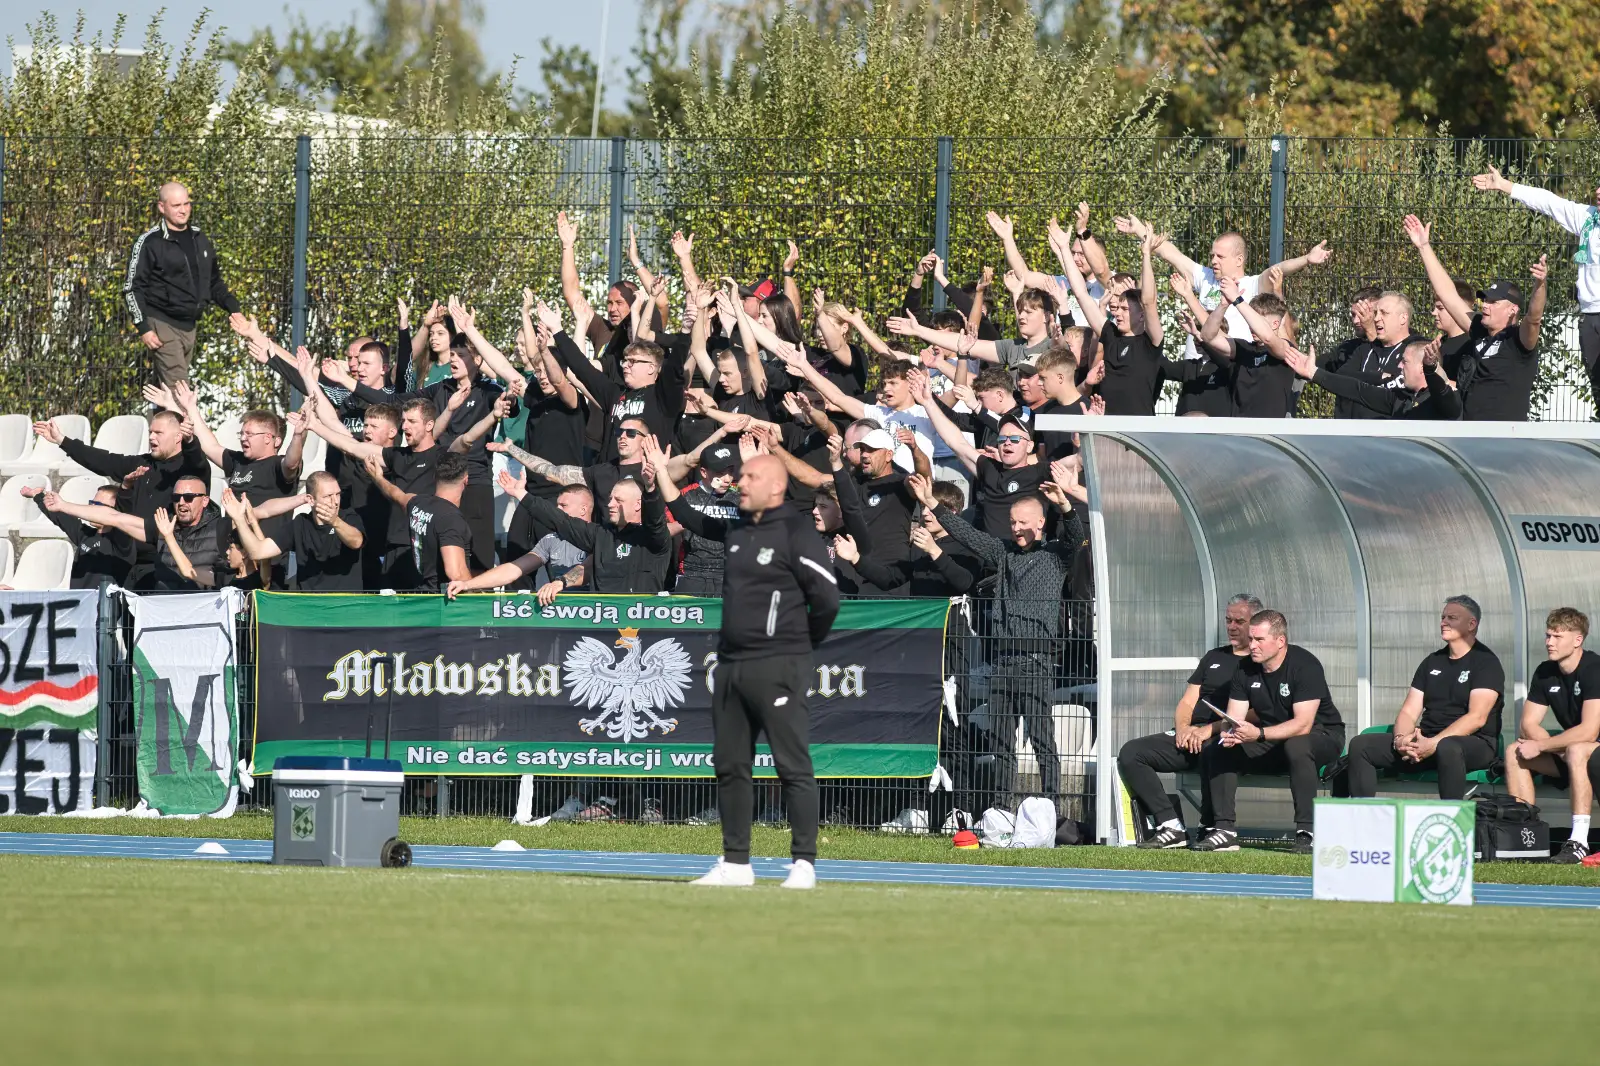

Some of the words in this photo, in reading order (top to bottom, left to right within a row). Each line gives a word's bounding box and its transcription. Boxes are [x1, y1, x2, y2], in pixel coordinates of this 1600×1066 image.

[1521, 521, 1600, 543] GOSPOD
[492, 600, 533, 618] Iść
[541, 602, 619, 624] swoją
[627, 602, 704, 624] drogą
[323, 650, 562, 701] Mławska
[147, 673, 224, 775] M
[407, 746, 449, 764] Nie
[458, 748, 508, 765] dać
[516, 748, 661, 770] satysfakcji
[289, 788, 320, 799] IGLOO
[1350, 850, 1391, 865] suez
